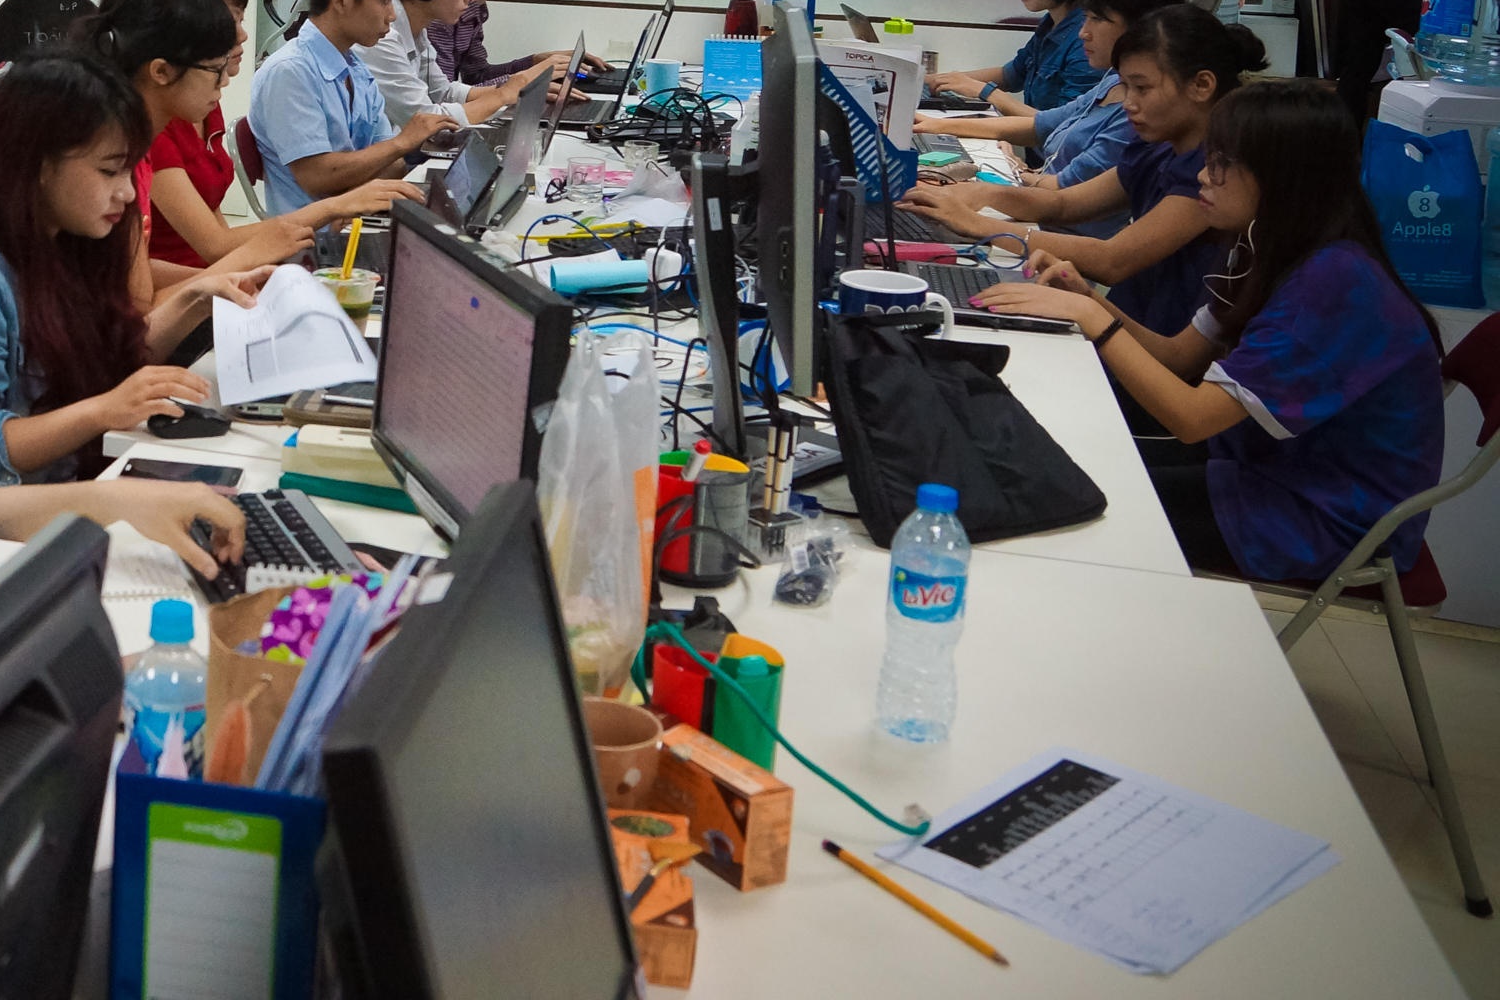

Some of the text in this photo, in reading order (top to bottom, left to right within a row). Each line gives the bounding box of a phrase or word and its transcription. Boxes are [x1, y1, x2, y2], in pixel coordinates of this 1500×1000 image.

[845, 52, 875, 63] TOPICA
[1420, 198, 1430, 212] 8
[1392, 221, 1452, 238] Apple8
